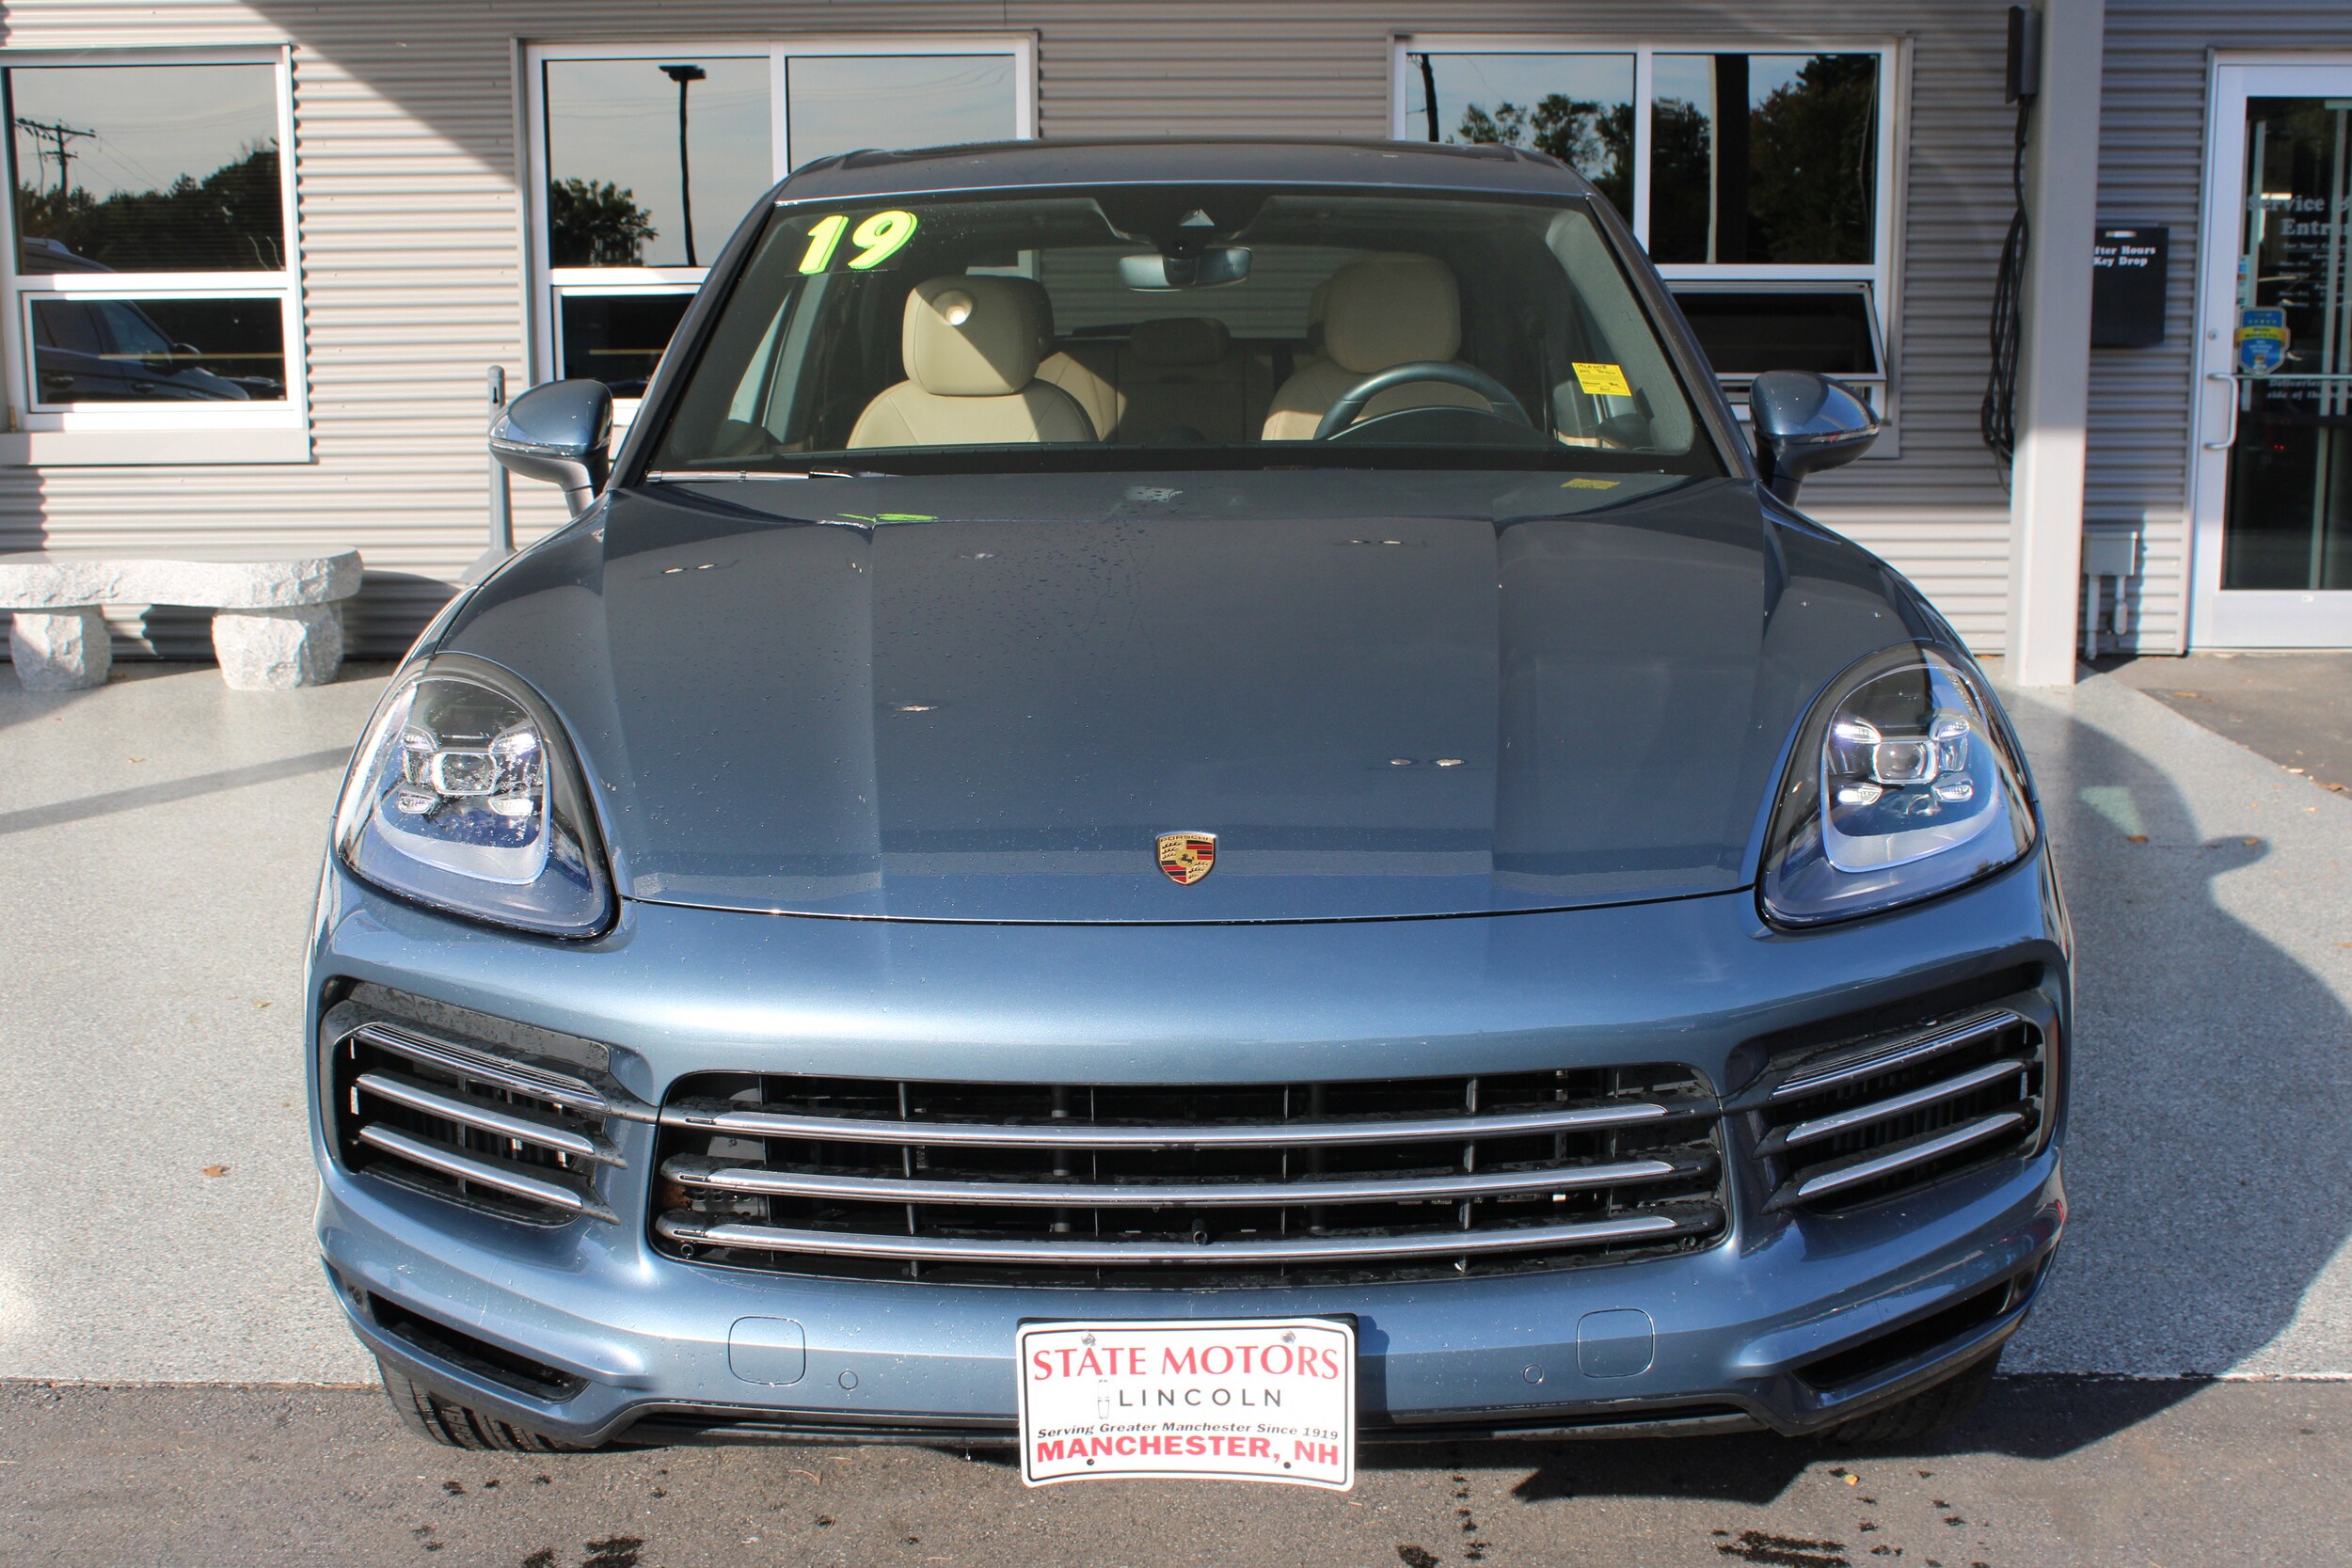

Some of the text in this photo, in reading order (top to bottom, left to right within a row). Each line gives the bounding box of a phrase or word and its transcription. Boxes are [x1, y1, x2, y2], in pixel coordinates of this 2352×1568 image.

[798, 210, 918, 275] 19
[2094, 245, 2156, 255] fter Hours
[2093, 256, 2148, 267] Key Drop
[1033, 1344, 1339, 1380] STATE MOTORS
[1120, 1388, 1281, 1407] LINCOLN
[1037, 1422, 1339, 1440] Serving Greater Manchester Since 1919
[1037, 1435, 1339, 1465] MANCHESTER, NH
